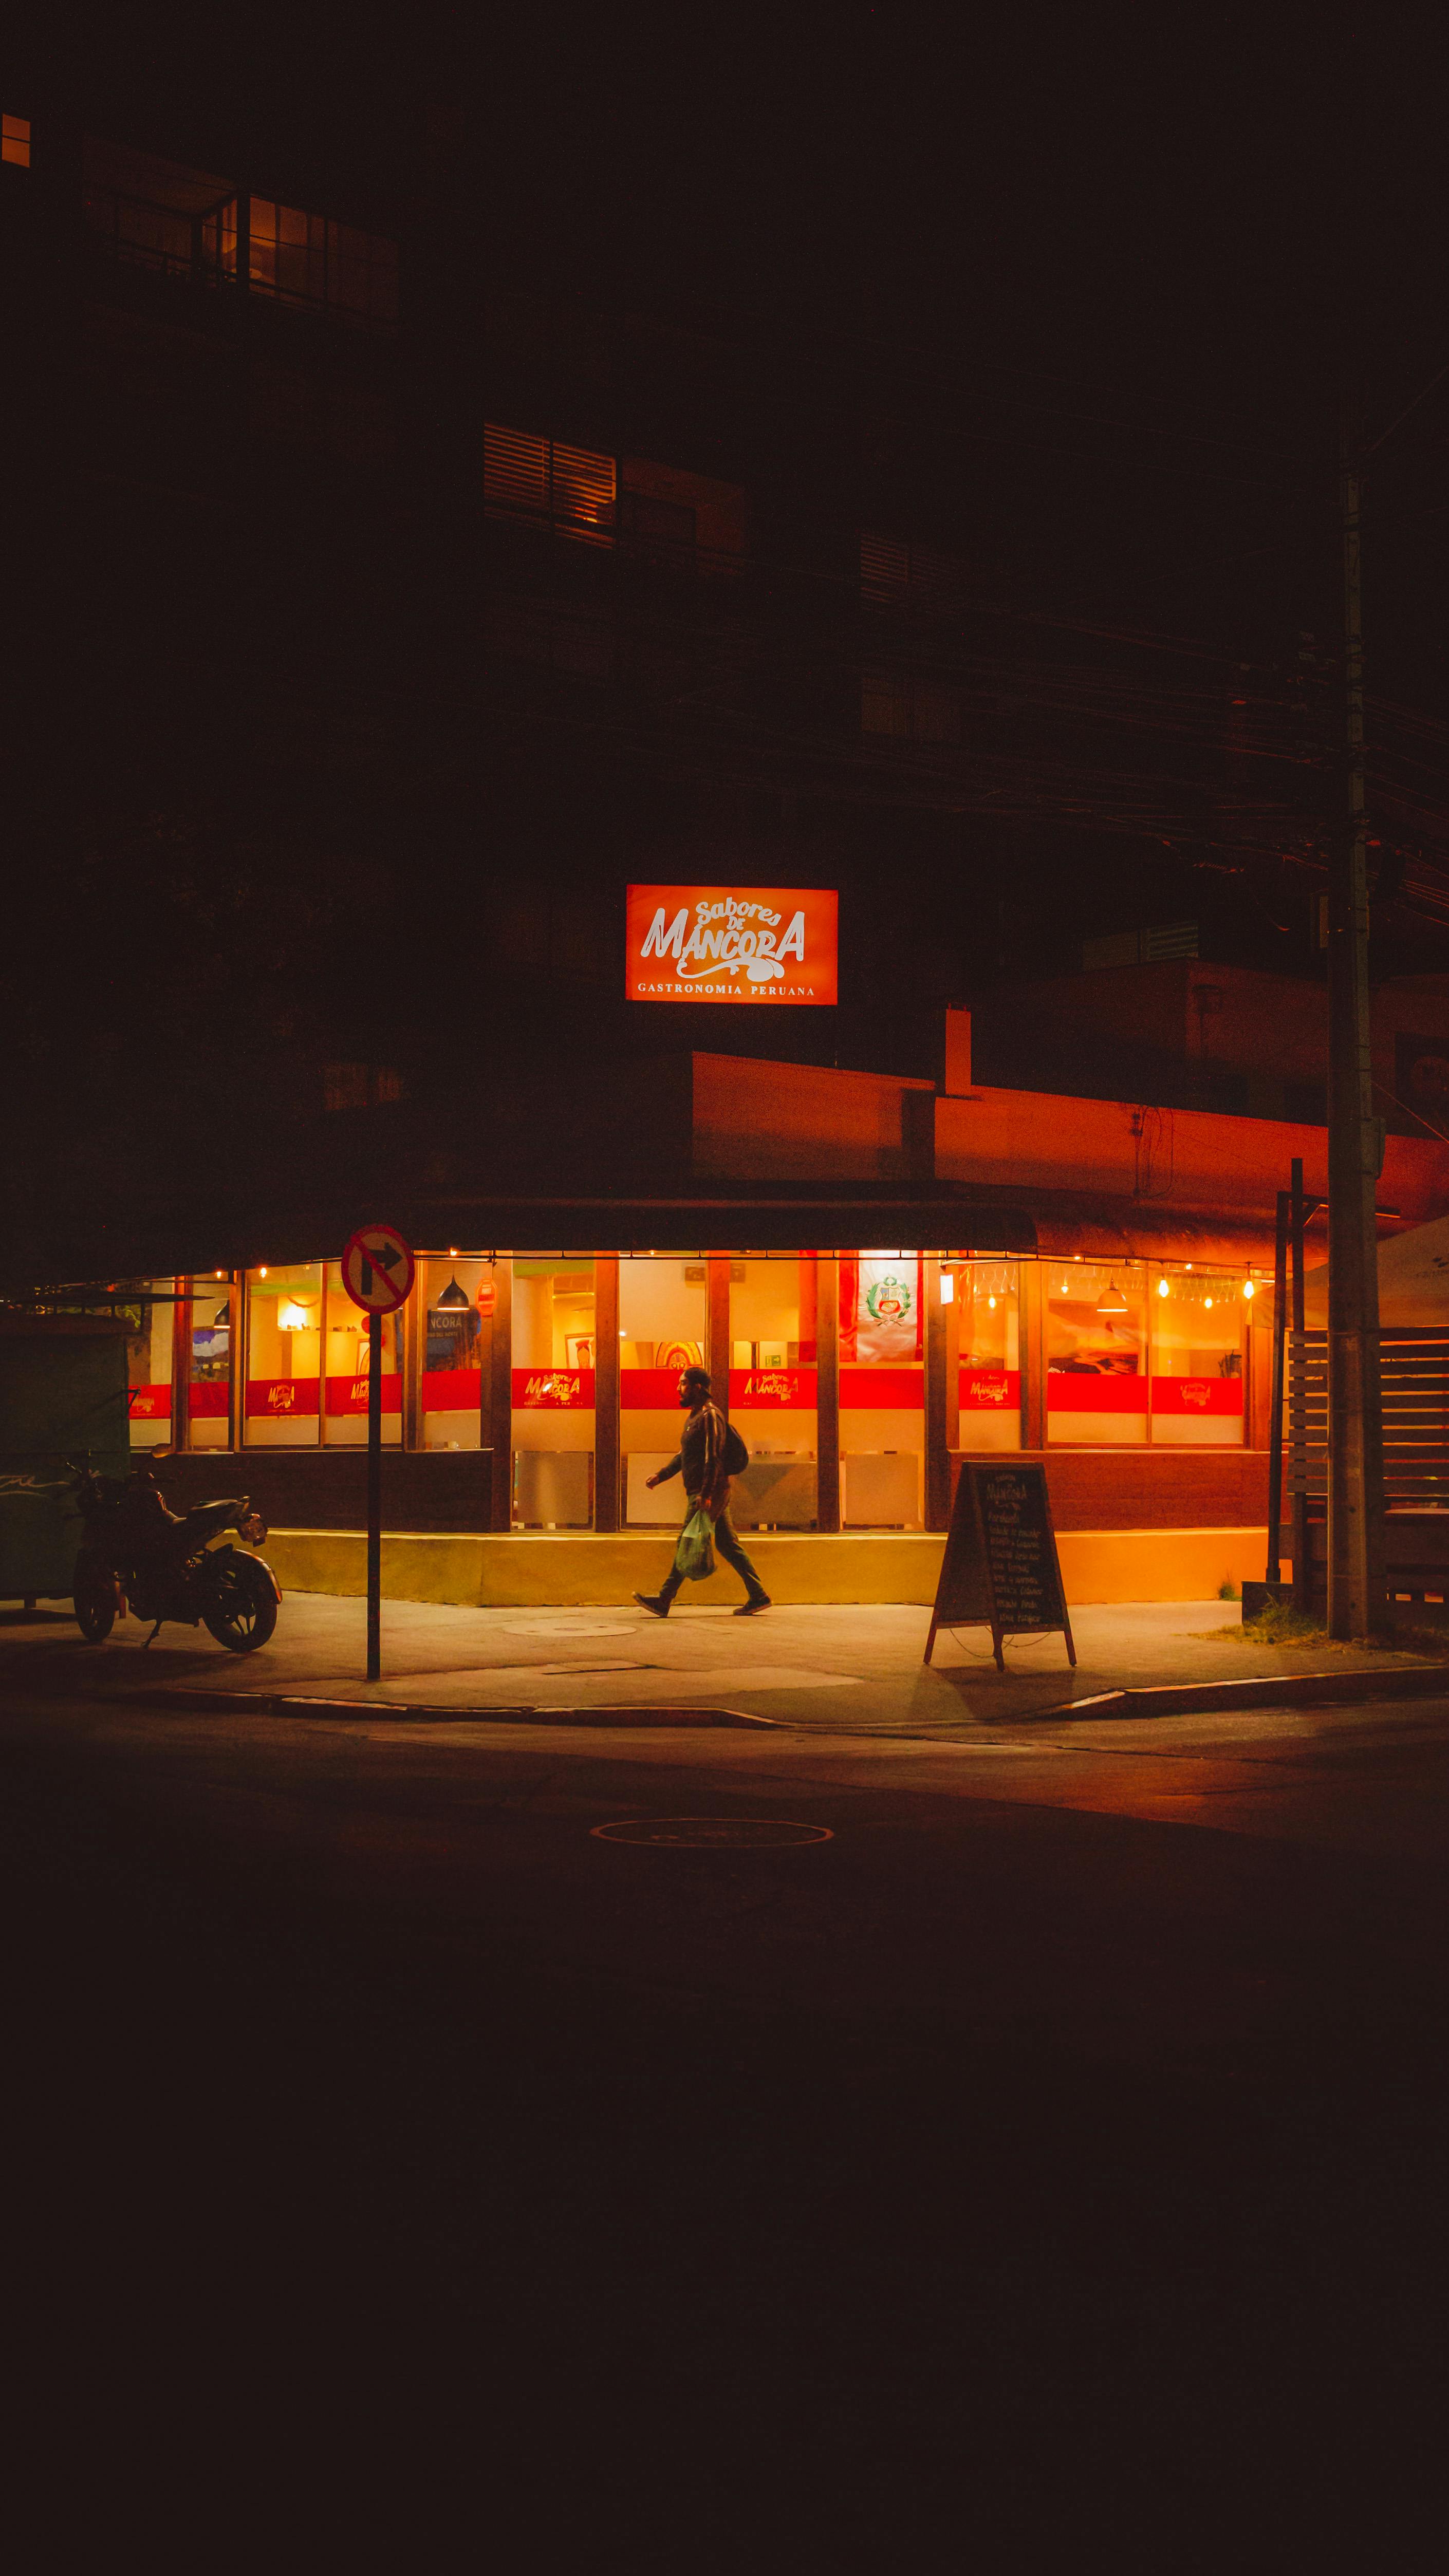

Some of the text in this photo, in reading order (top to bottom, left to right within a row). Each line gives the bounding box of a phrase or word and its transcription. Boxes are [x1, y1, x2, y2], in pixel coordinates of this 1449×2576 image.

[696, 897, 782, 926] Sabores
[727, 916, 745, 930] DE
[638, 983, 814, 996] GASTRONOMIA PERUANA
[431, 1316, 462, 1329] NCORA
